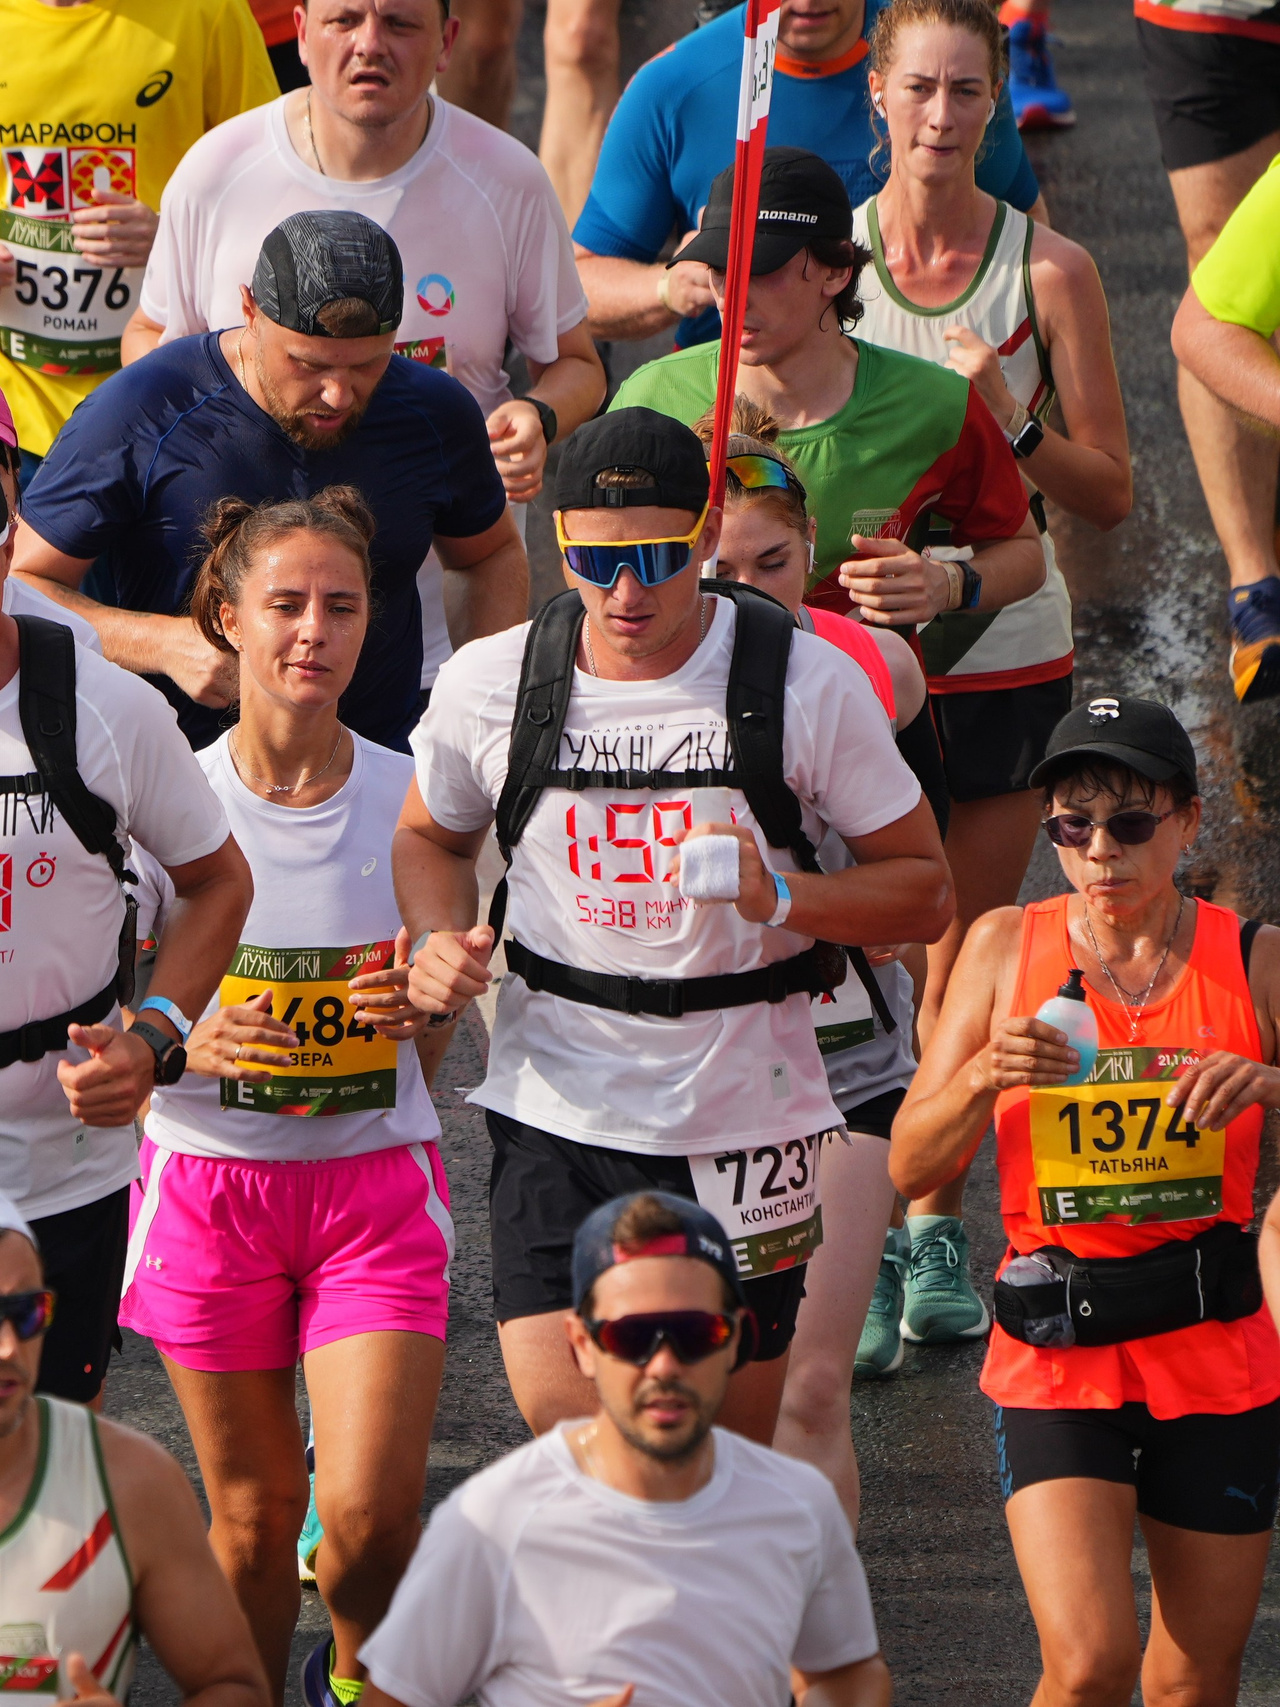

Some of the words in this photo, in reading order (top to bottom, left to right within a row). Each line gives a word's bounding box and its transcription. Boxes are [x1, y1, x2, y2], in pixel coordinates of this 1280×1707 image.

[758, 210, 818, 224] noname
[8, 220, 81, 252] ЛУЖНИК
[15, 260, 130, 314] 5376
[43, 315, 98, 331] РОМАН
[10, 331, 26, 360] E
[411, 346, 429, 358] КМ
[576, 895, 636, 929] 5:38
[647, 916, 671, 929] КМ
[235, 952, 320, 979] ЛУЖНИКИ
[345, 954, 364, 965] 21,1
[365, 950, 381, 962] КМ
[290, 1053, 333, 1066] ВЕРА
[1158, 1055, 1179, 1066] 21,1
[237, 1081, 255, 1104] E
[1059, 1098, 1200, 1155] 1374
[1089, 1156, 1169, 1174] ТАТЬЯНА
[741, 1192, 815, 1225] КОНСТАНТИ
[1056, 1192, 1079, 1219] E
